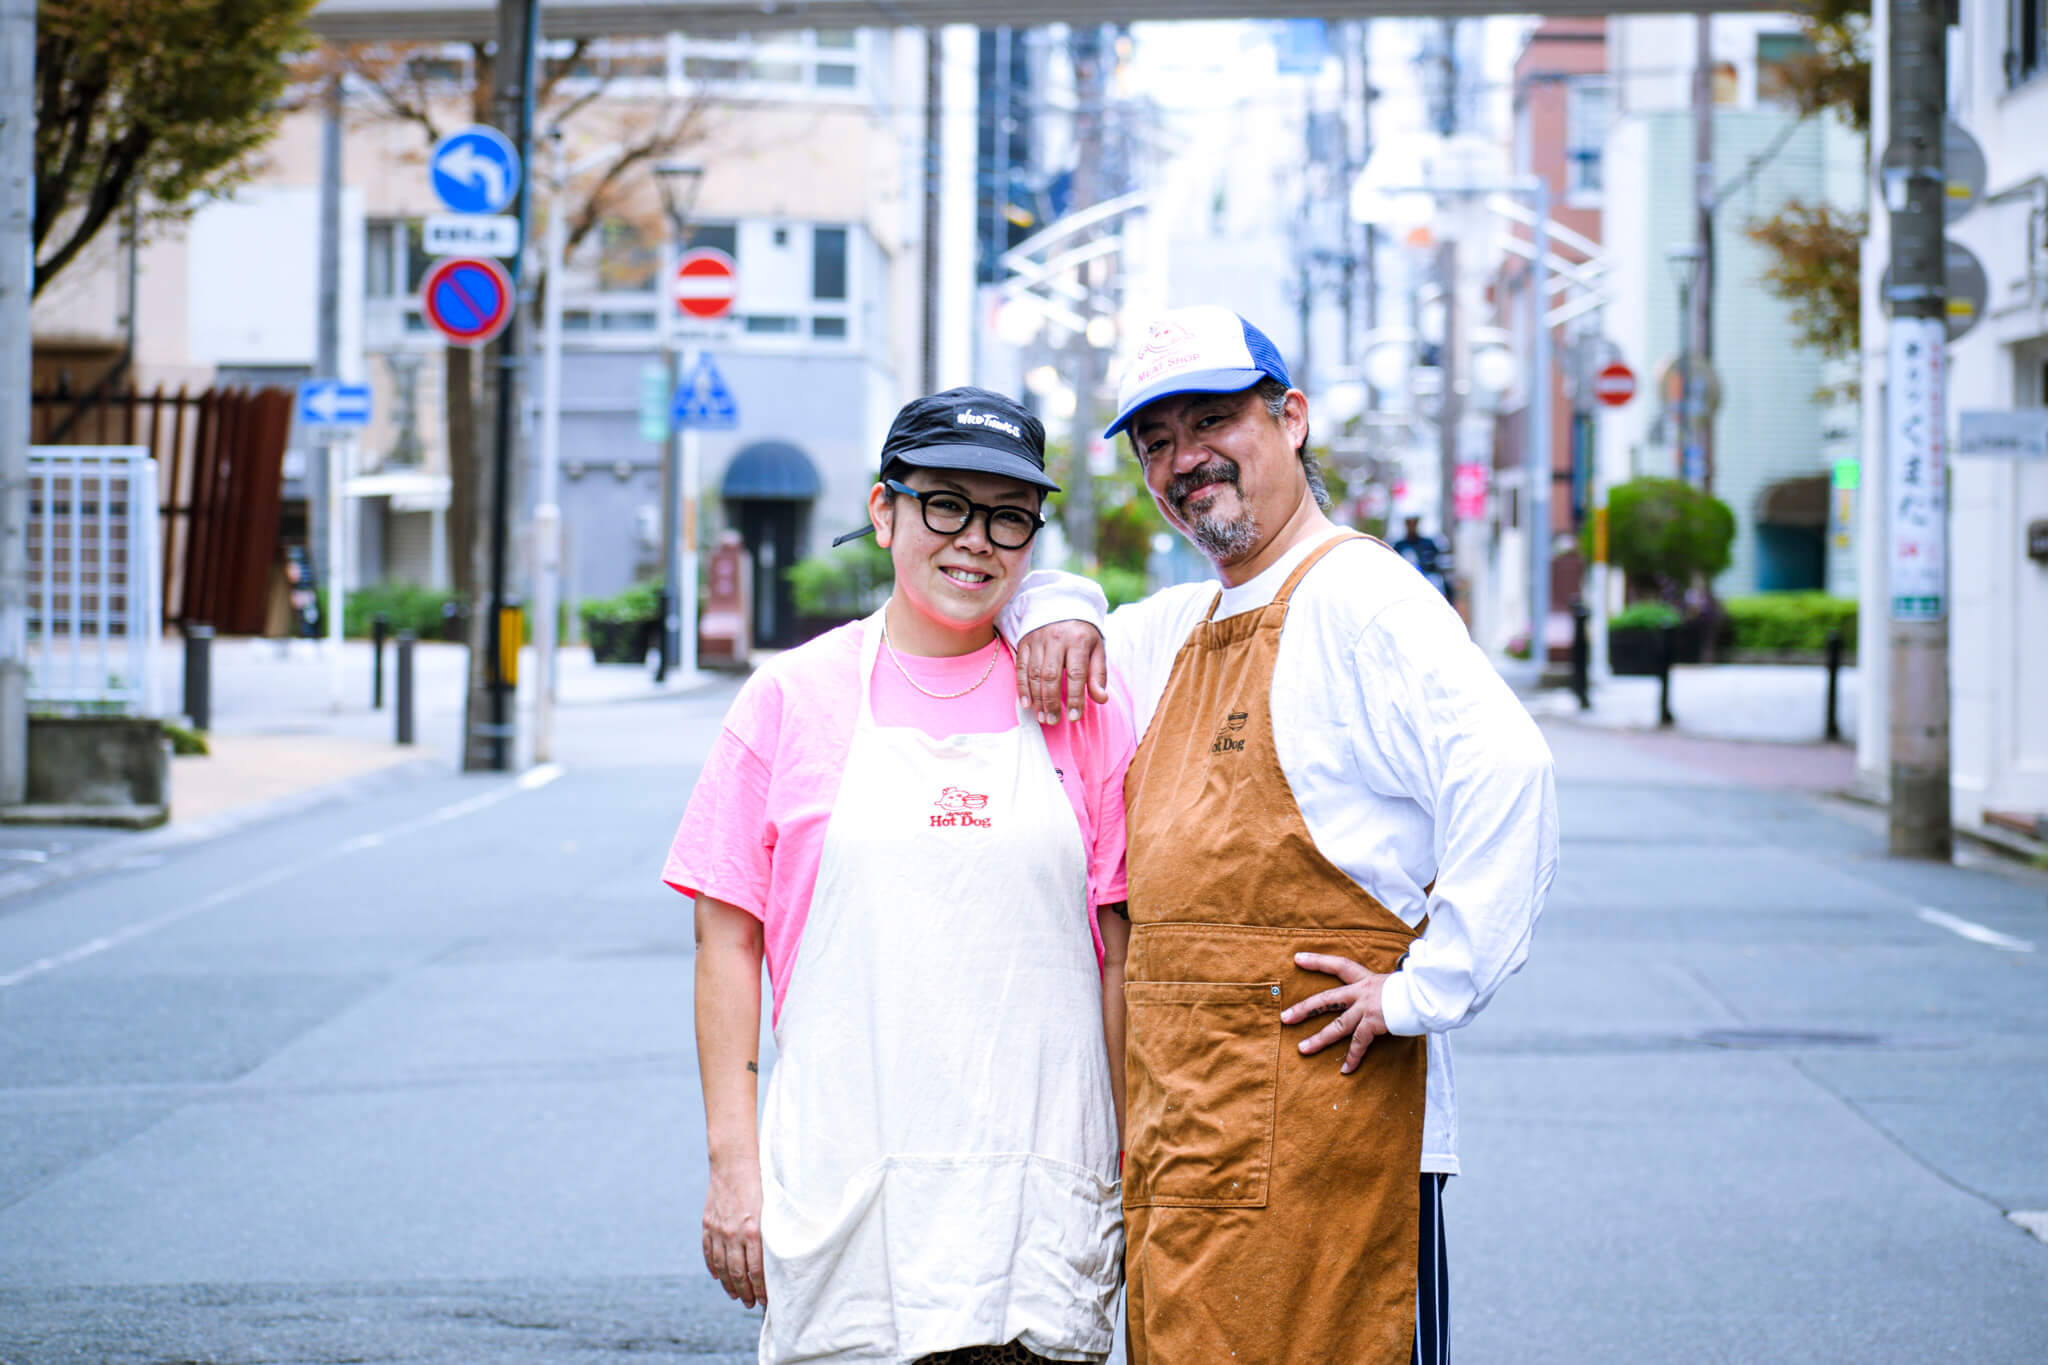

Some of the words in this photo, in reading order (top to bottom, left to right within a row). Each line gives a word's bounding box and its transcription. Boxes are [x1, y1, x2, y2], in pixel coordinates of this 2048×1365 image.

[1168, 353, 1200, 367] SHOP
[1223, 738, 1246, 752] Dog
[929, 815, 957, 828] Hot
[961, 815, 992, 829] Dog
